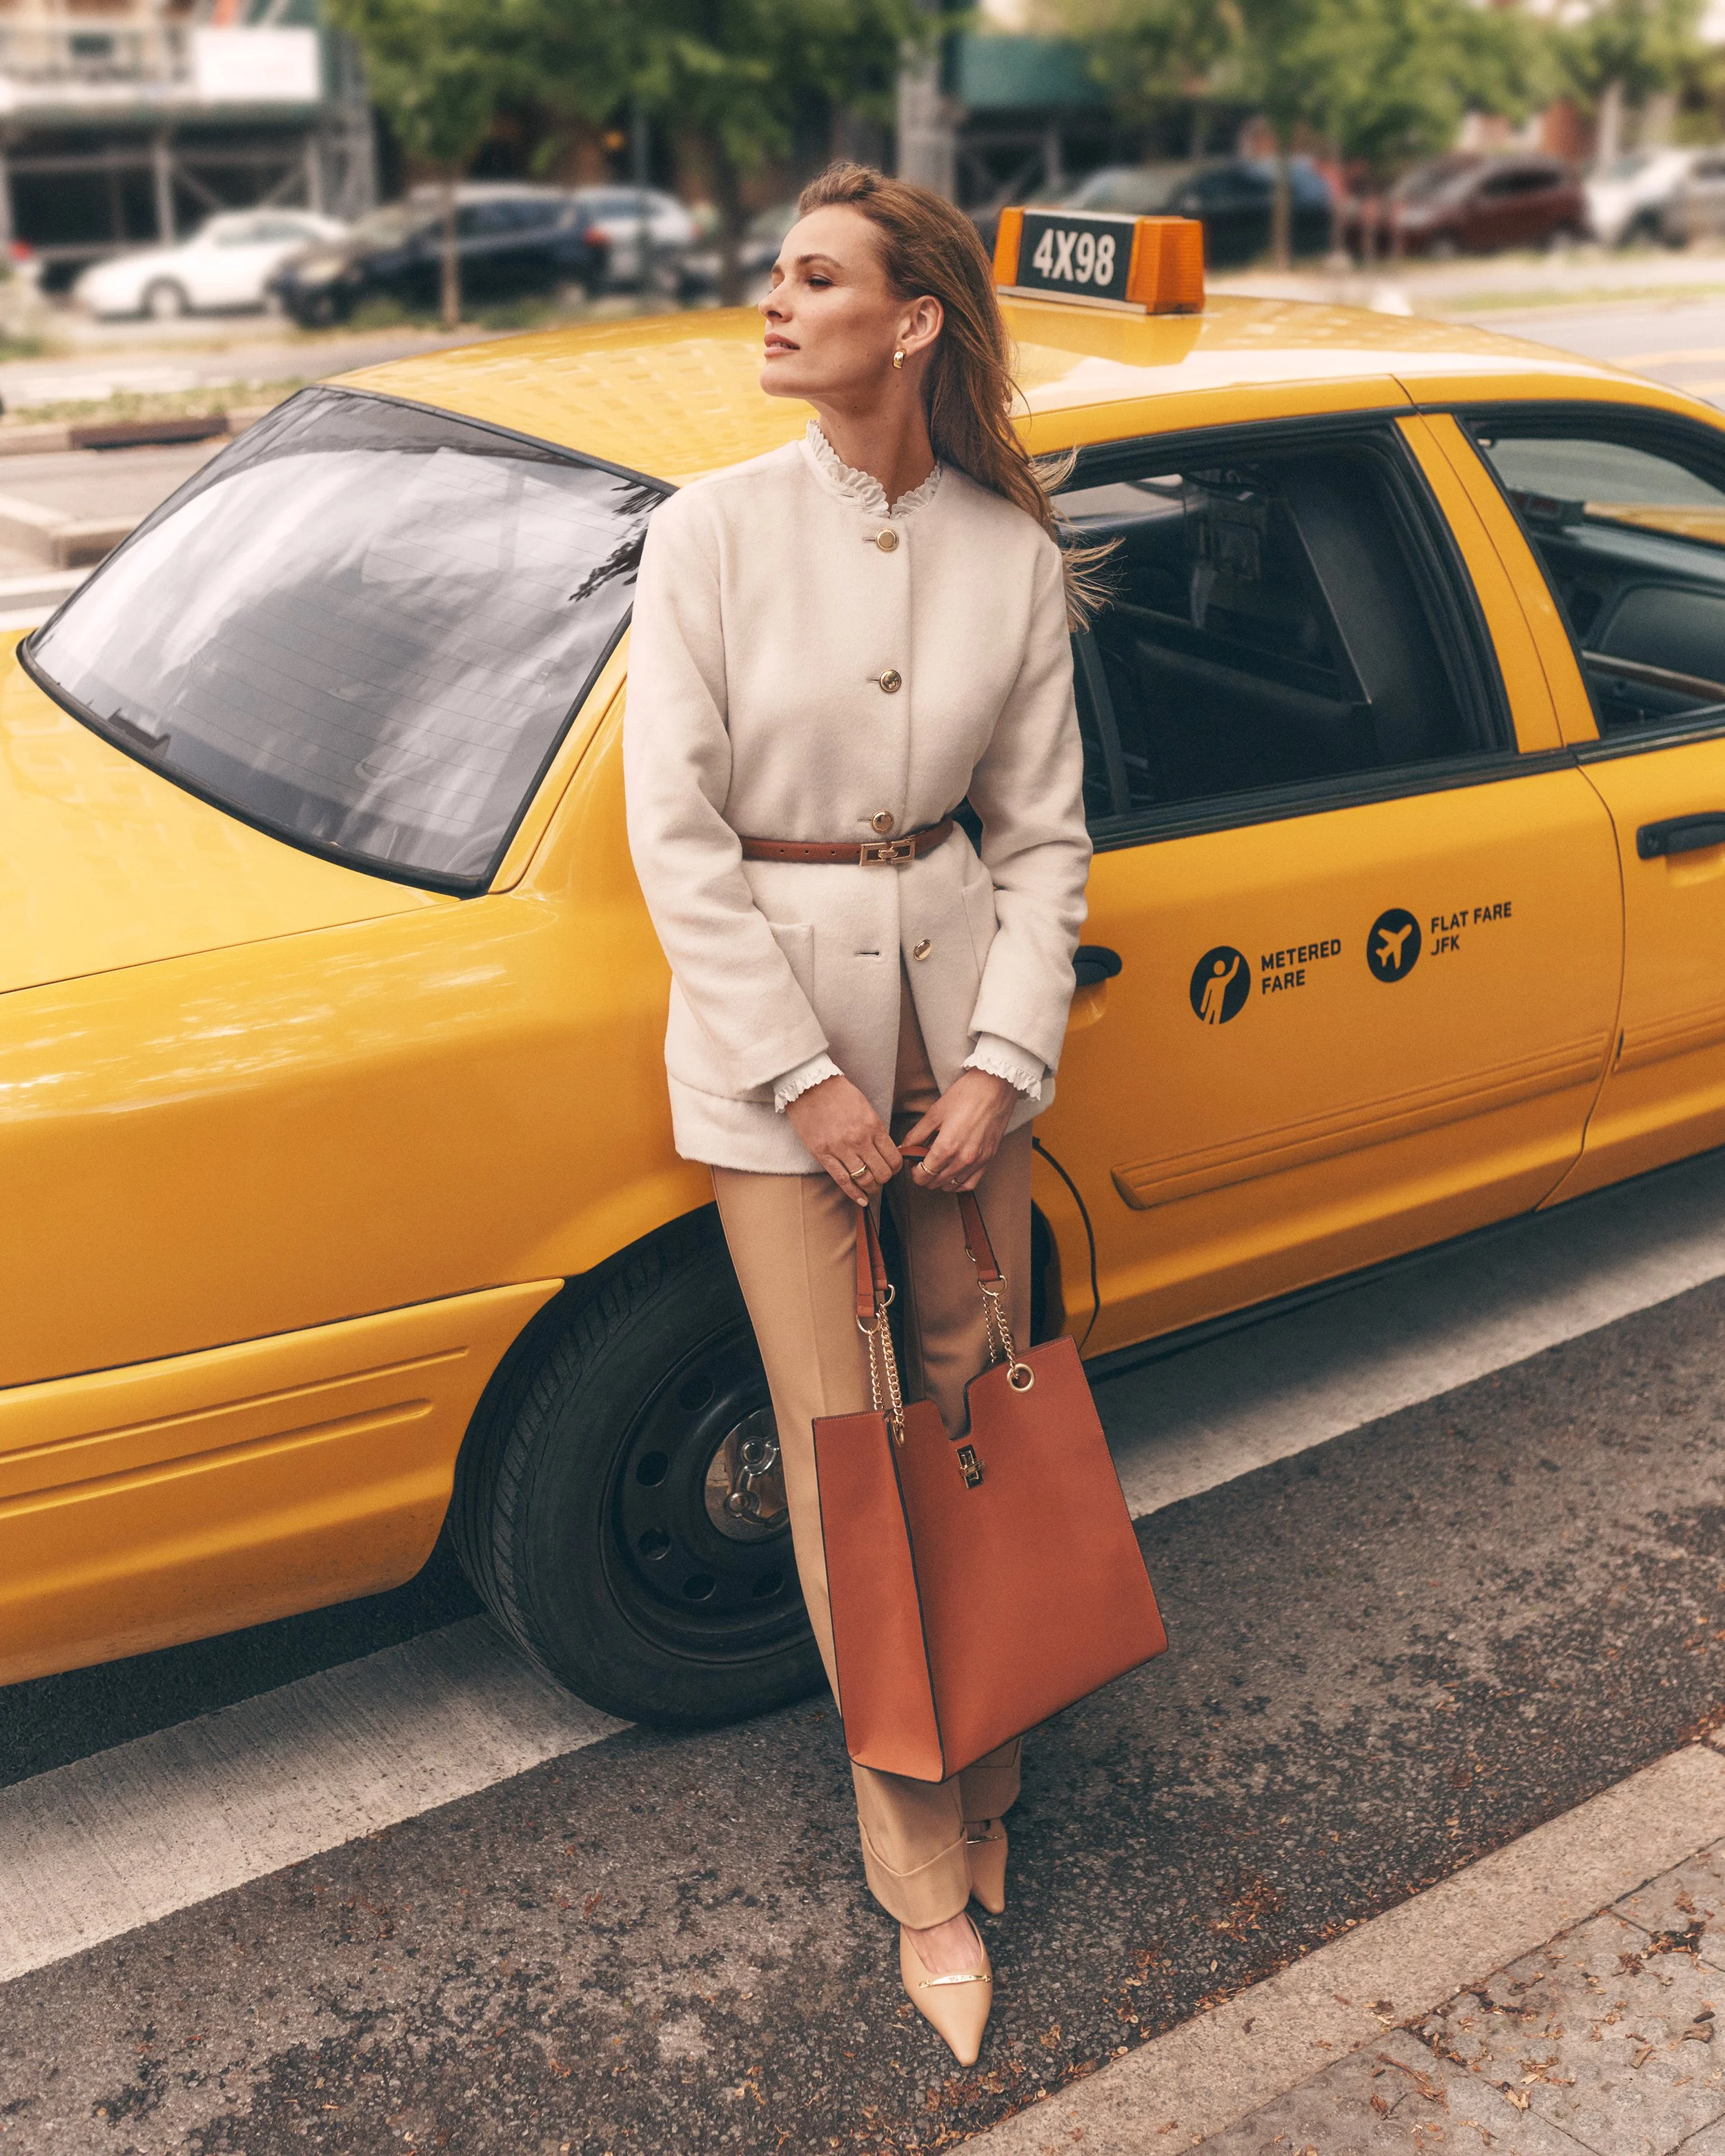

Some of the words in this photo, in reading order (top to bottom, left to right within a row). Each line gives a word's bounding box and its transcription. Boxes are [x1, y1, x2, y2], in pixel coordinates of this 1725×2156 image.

[1032, 228, 1116, 286] 4X98
[1430, 910, 1469, 934] FLAT
[1473, 901, 1512, 924] FARE
[1261, 938, 1341, 972] METERED
[1430, 934, 1460, 956] JFK
[1261, 969, 1305, 995] FARE
